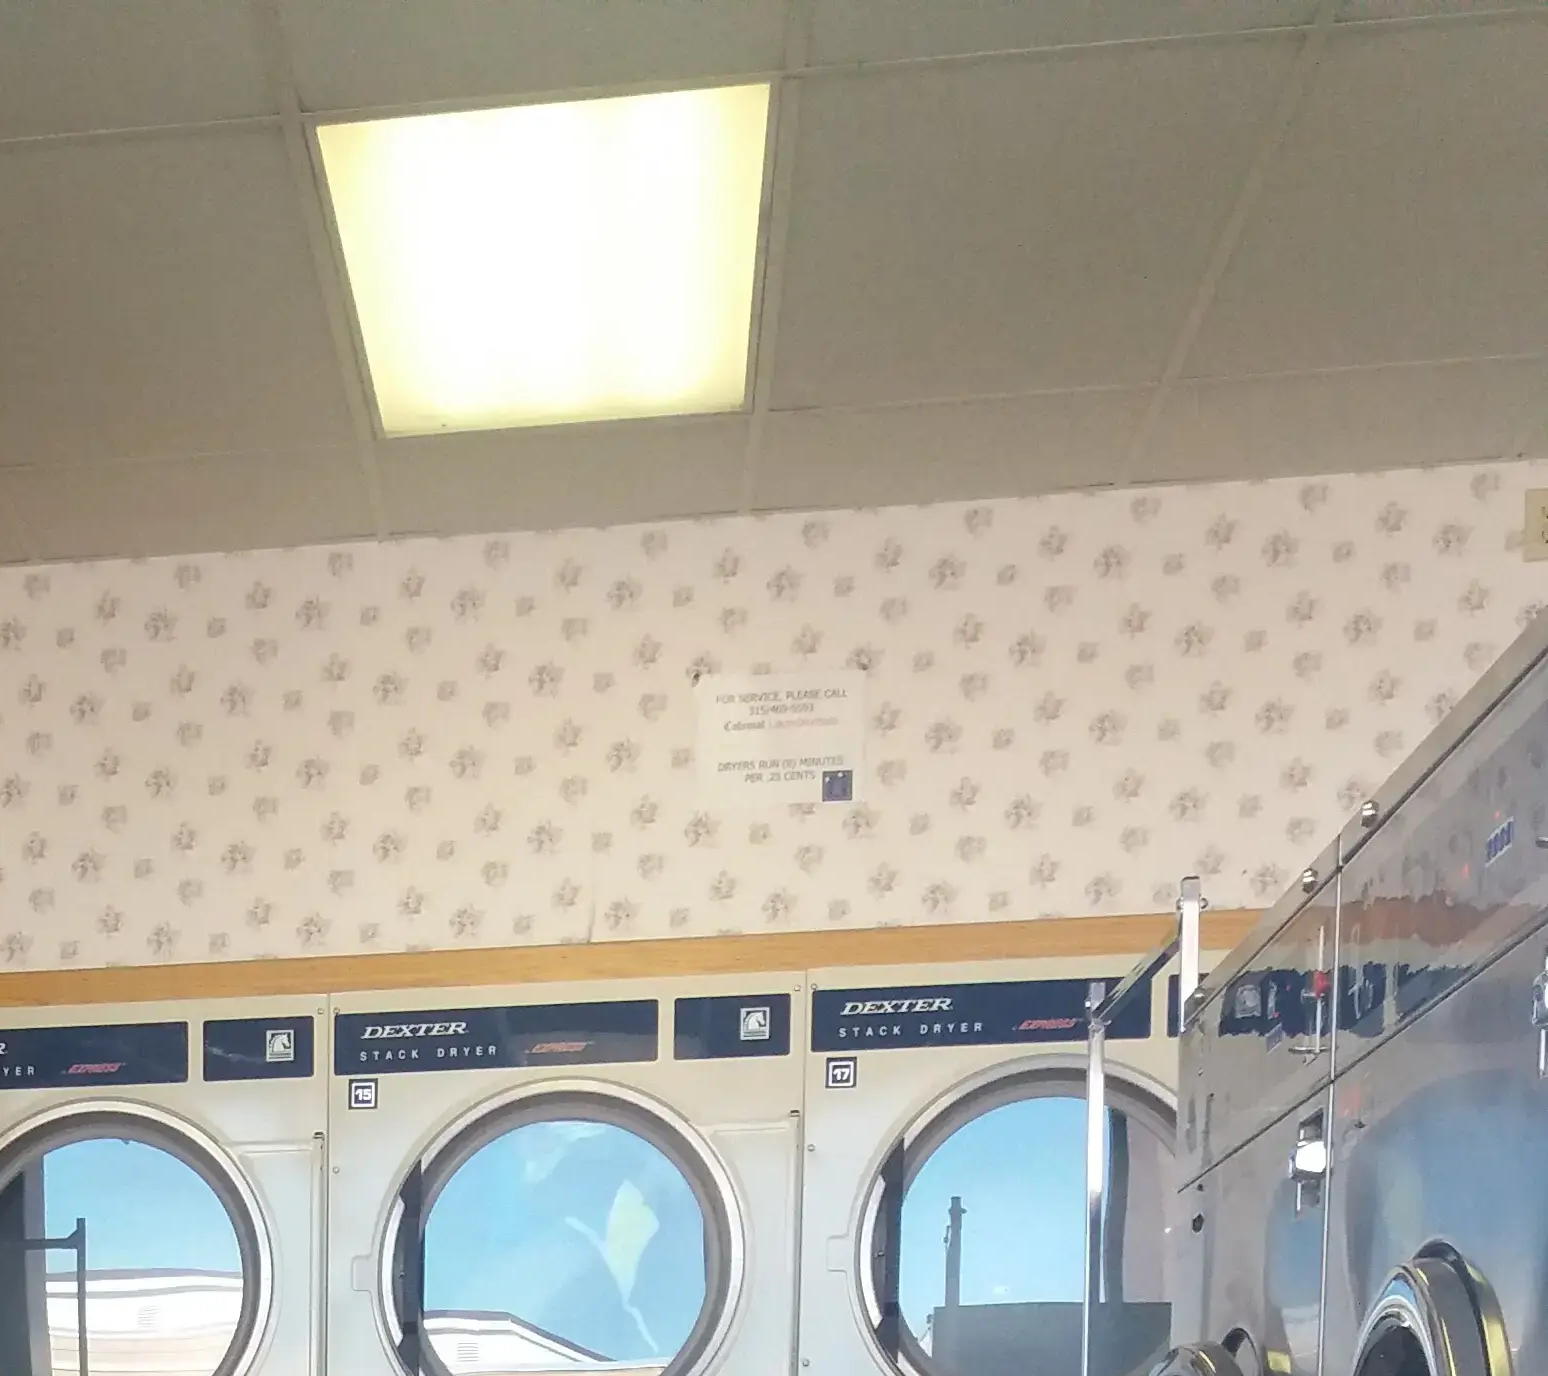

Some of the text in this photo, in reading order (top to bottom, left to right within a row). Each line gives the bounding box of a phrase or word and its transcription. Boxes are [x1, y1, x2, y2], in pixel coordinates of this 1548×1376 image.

[824, 688, 847, 699] CALL
[759, 759, 779, 770] RUN
[840, 997, 952, 1016] DEXTER
[361, 1021, 468, 1039] DEXTER
[839, 1022, 983, 1038] STACK DRYER
[360, 1045, 497, 1061] STACK DRYER
[833, 1067, 850, 1081] 17
[355, 1088, 372, 1101] 15
